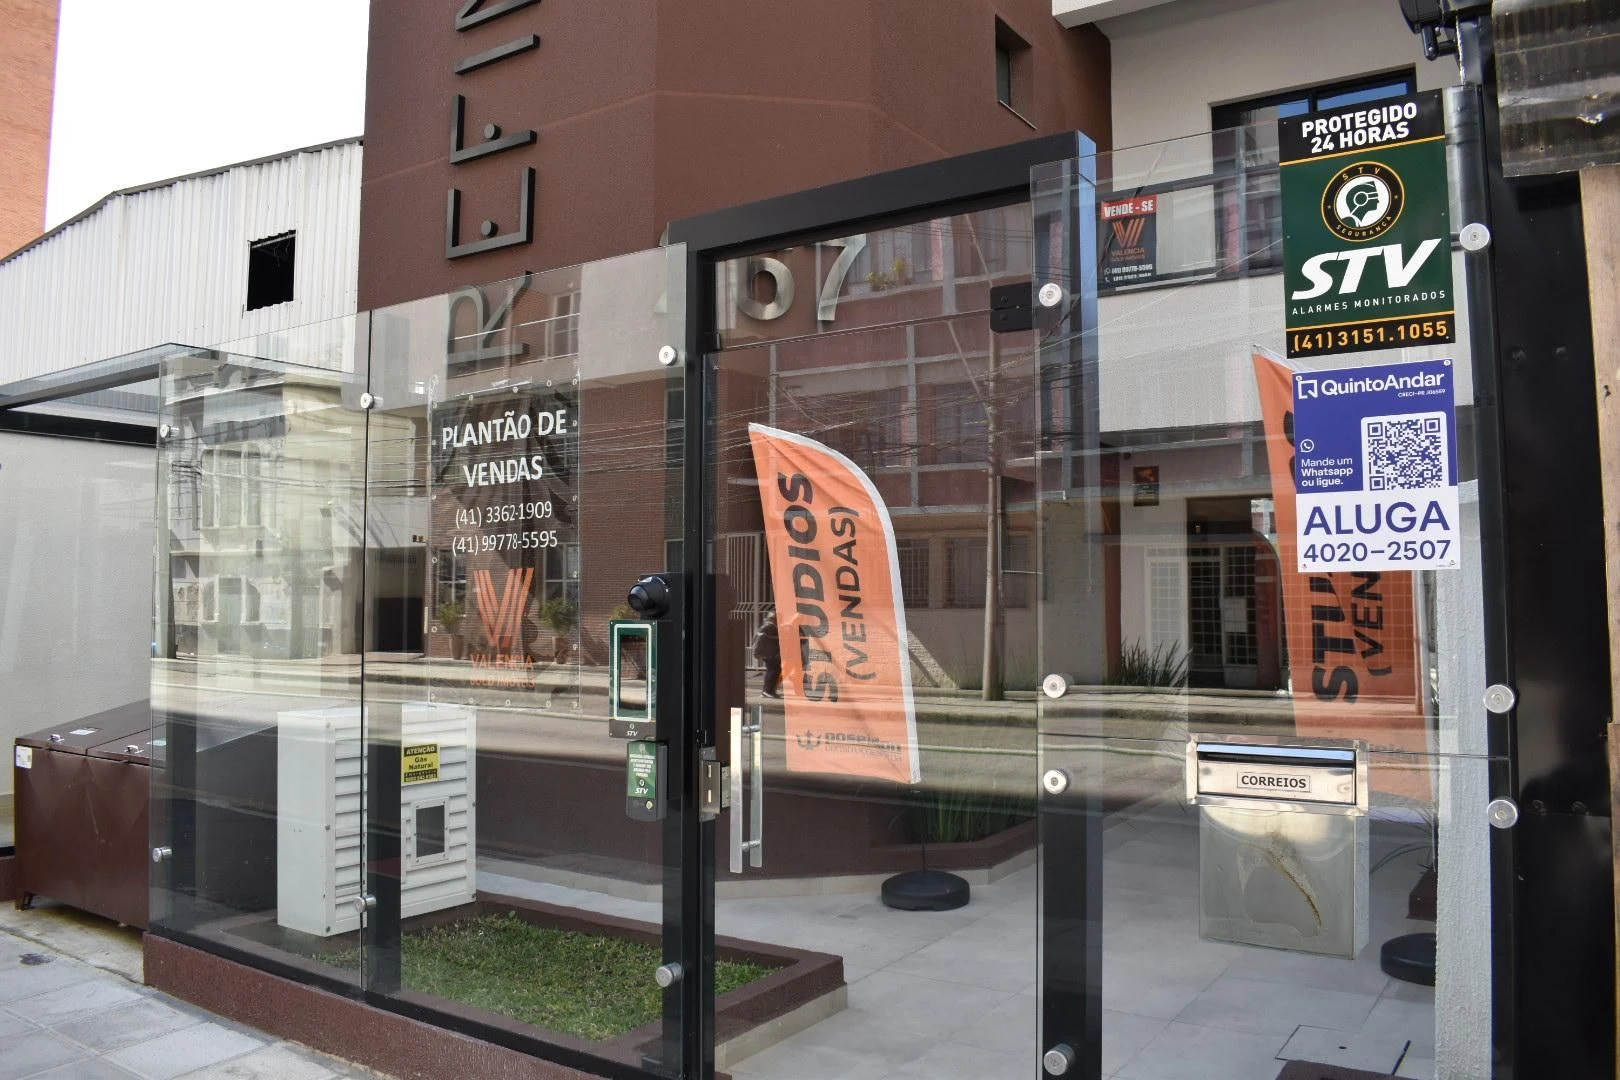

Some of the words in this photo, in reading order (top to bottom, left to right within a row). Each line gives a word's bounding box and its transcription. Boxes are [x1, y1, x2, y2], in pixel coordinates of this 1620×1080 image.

[1301, 102, 1418, 138] PROTEGIDO
[1310, 135, 1335, 154] 24
[1340, 121, 1410, 149] HORAS
[1342, 167, 1381, 181] STV
[1104, 203, 1134, 218] VENDE
[1141, 200, 1153, 211] SE
[1291, 238, 1442, 301] STV
[1292, 301, 1348, 316] ALARMES
[1354, 290, 1446, 308] MONITORADOS
[1294, 320, 1448, 352] (41)3151.1055
[1321, 372, 1445, 396] QuintoAndar
[442, 410, 531, 450] PLANTÃO
[538, 409, 567, 436] DE
[463, 455, 543, 488] VENDAS
[1301, 457, 1335, 467] Mande
[1336, 456, 1353, 466] um
[1301, 467, 1354, 478] Whatsapp
[1301, 479, 1315, 487] ou
[1316, 477, 1344, 488] ligue.
[455, 506, 482, 529] (41)
[486, 500, 552, 524] 3362-1909
[1303, 500, 1450, 536] ALUGA
[452, 535, 479, 557] (41)
[481, 530, 558, 552] 99778-5595
[1303, 539, 1451, 563] 4020-2507
[778, 471, 839, 703] STUDIOS
[828, 506, 877, 681] (VENDAS)
[470, 653, 535, 671] VALENCIA
[406, 746, 435, 755] ATENÇÃO
[1241, 775, 1307, 789] CORREIOS
